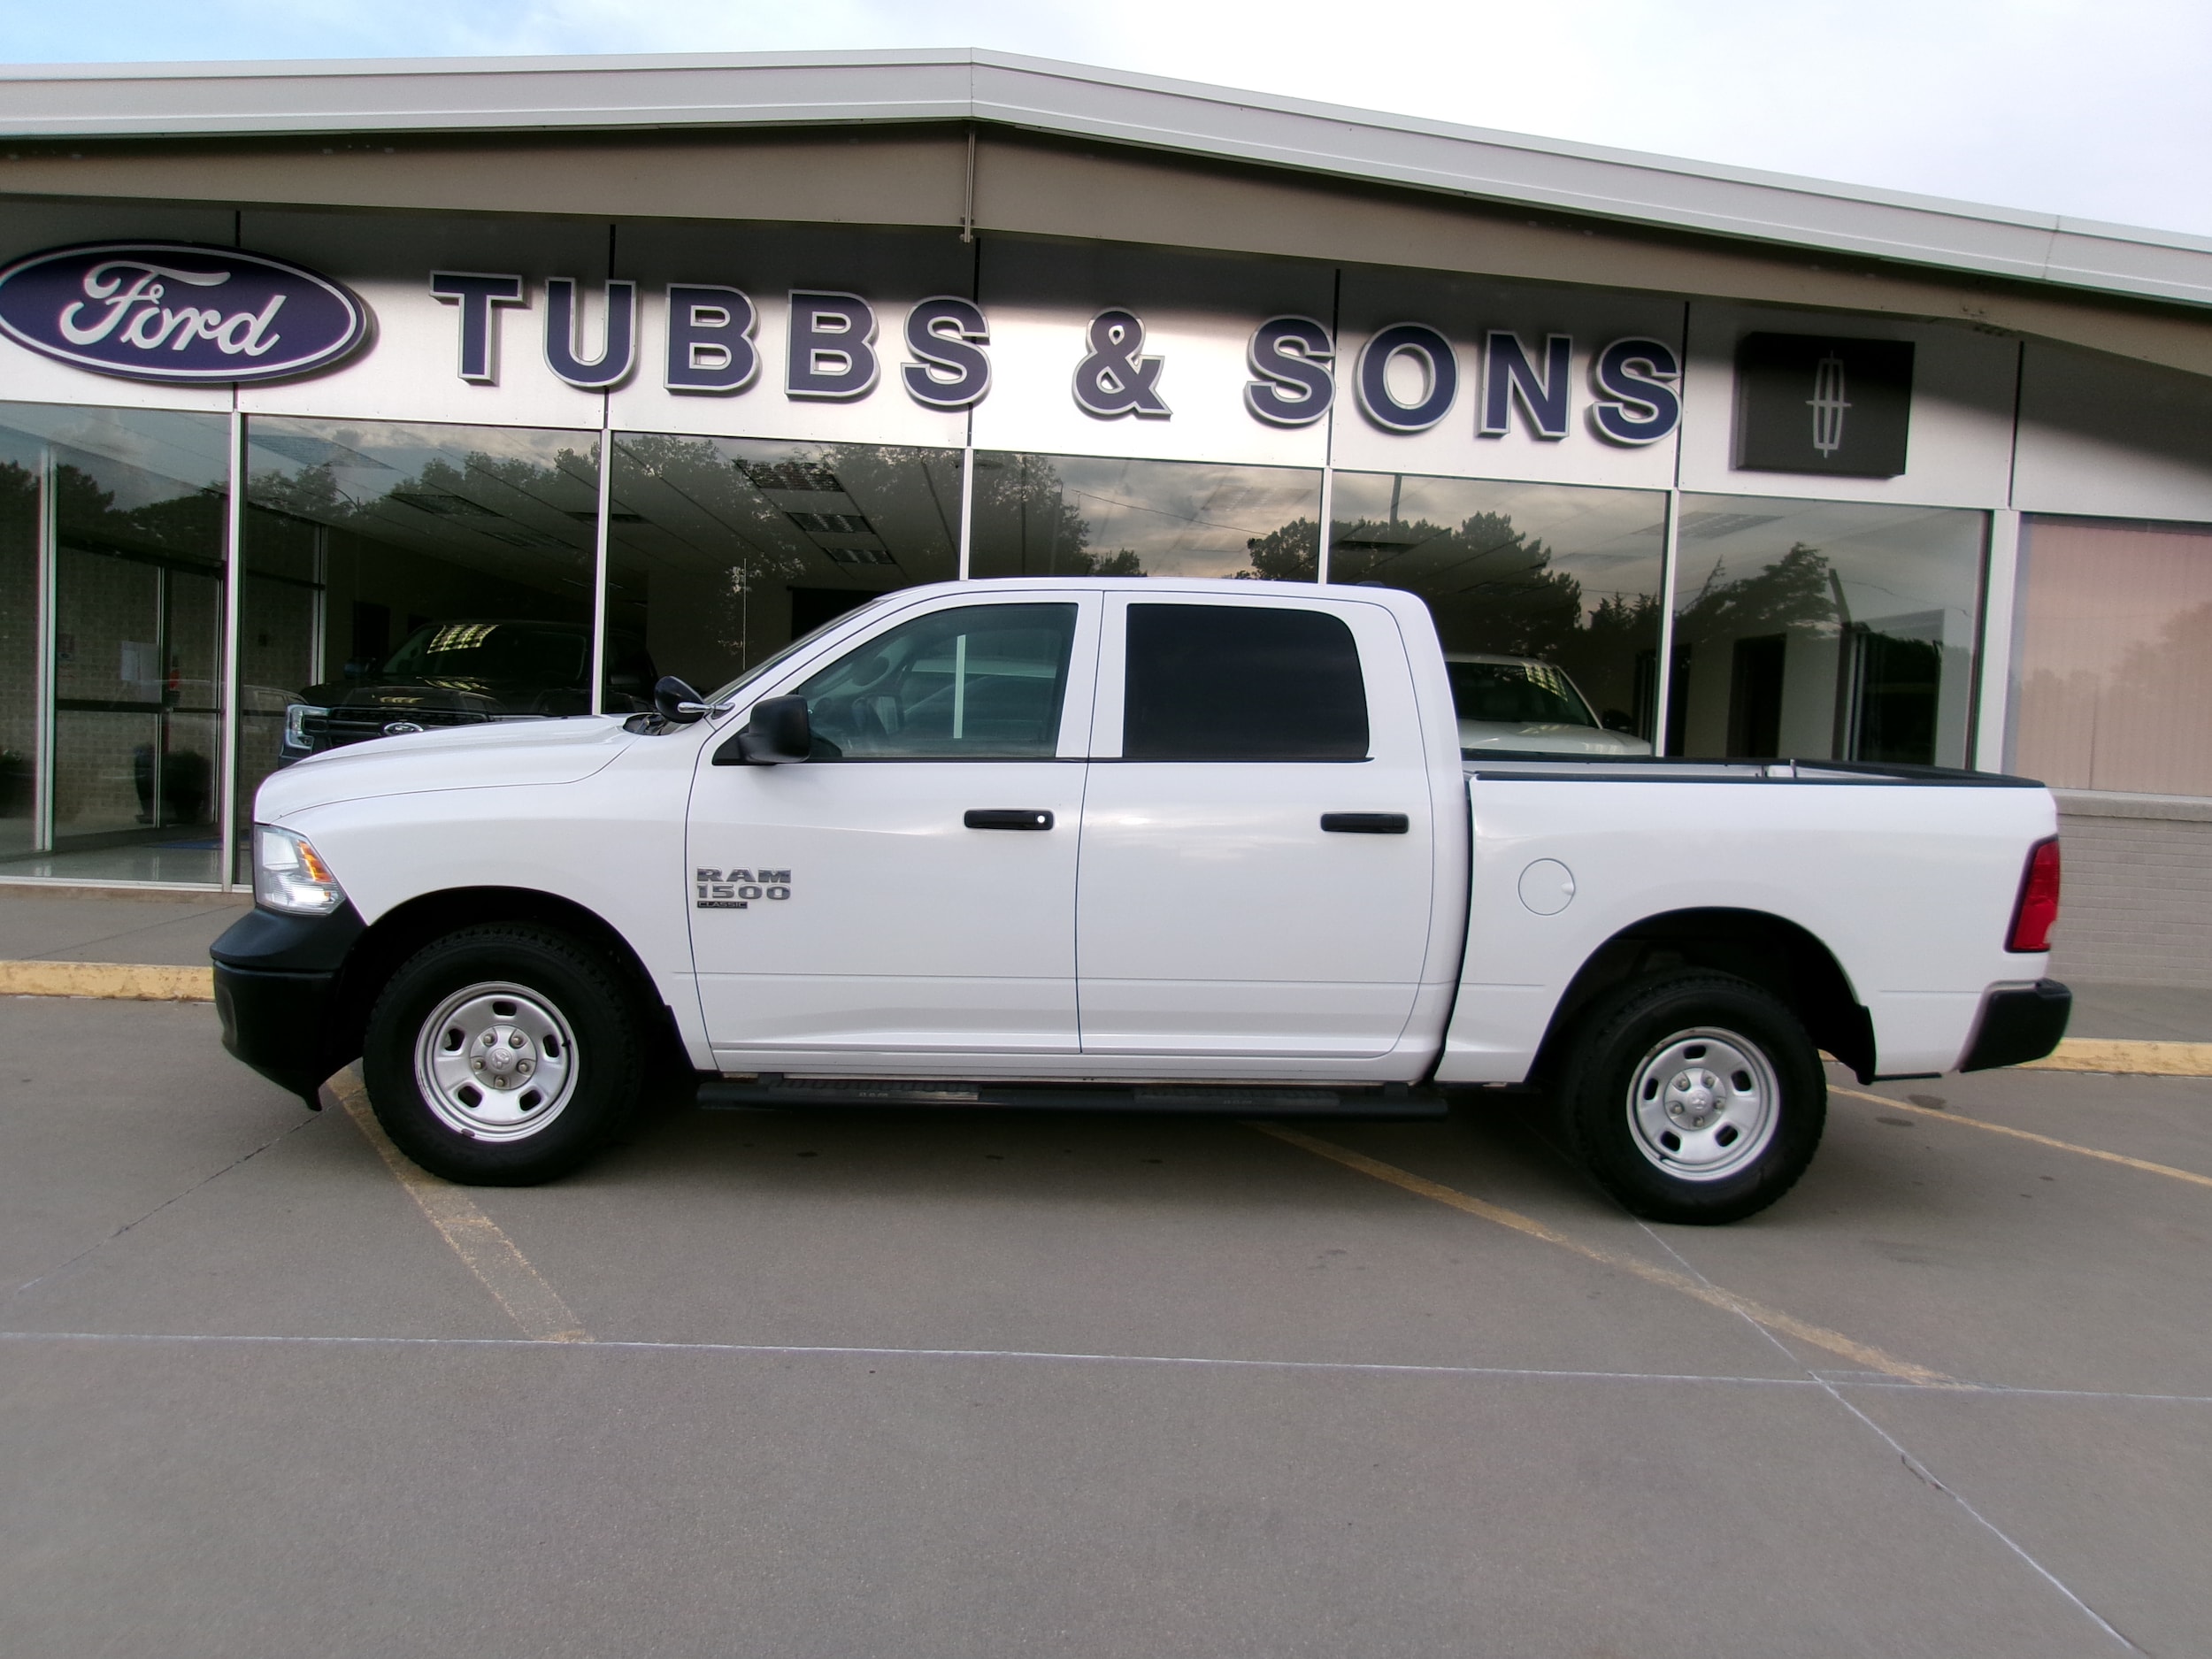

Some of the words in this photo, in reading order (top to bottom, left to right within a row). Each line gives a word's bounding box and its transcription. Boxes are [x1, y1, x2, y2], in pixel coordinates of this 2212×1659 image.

[59, 260, 287, 357] Ford
[429, 269, 992, 407] TUBBS
[1071, 306, 1172, 421] &
[1245, 314, 1683, 448] SONS
[696, 866, 791, 883] RAM
[696, 883, 791, 901] 1500
